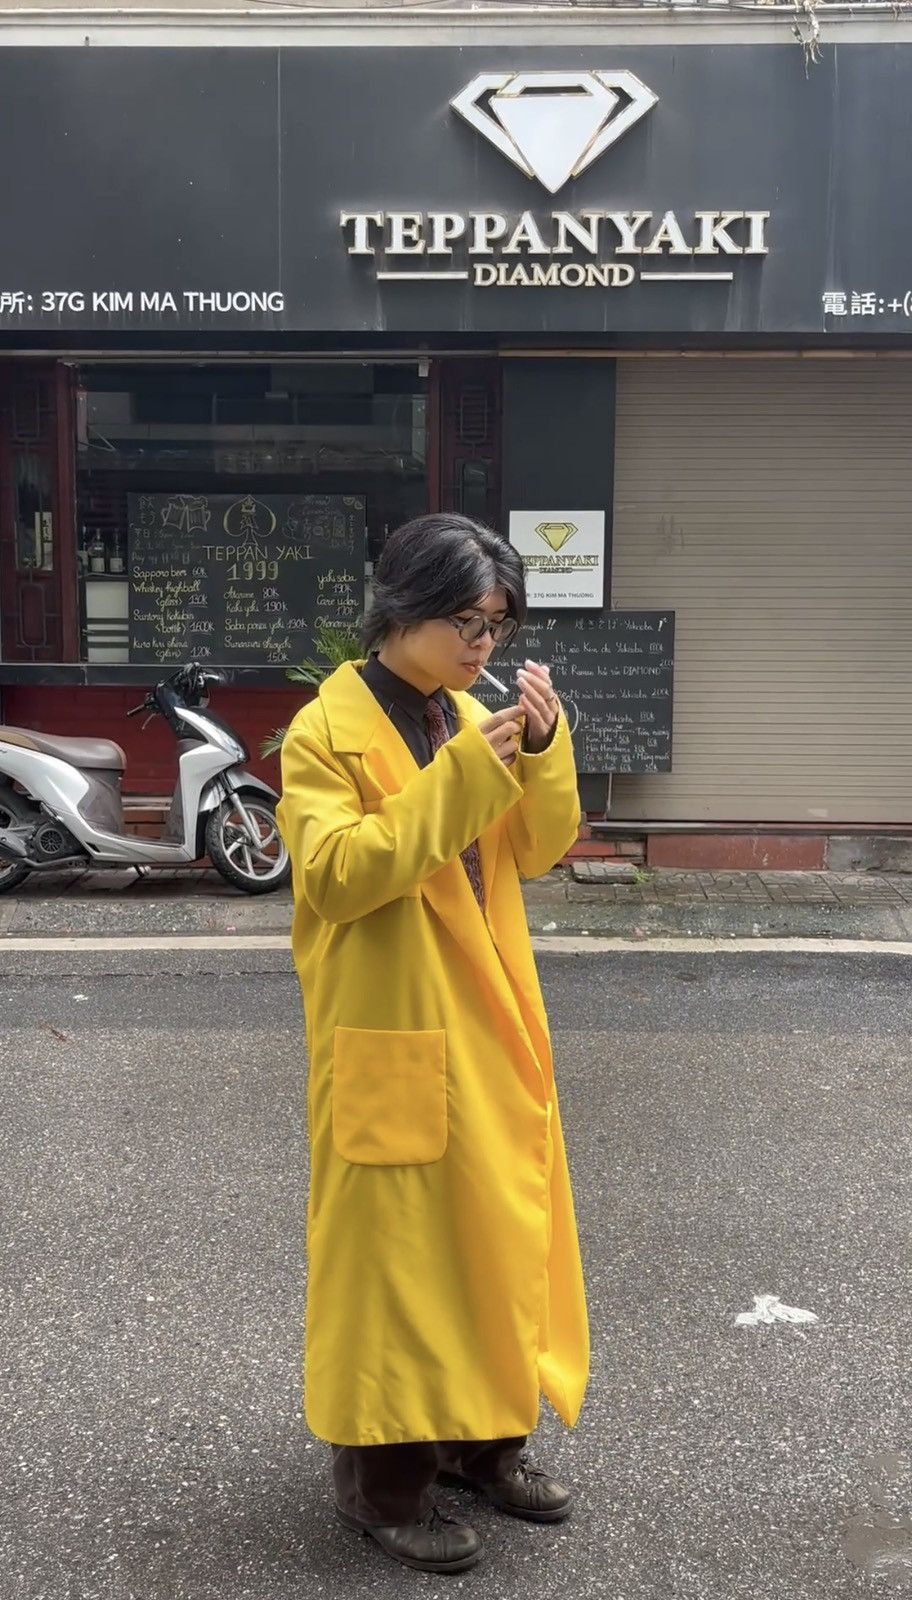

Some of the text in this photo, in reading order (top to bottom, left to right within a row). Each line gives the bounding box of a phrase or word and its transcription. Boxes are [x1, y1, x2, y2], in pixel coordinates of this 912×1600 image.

[340, 209, 770, 255] TEPPANYAKI
[473, 263, 635, 287] DIAMOND
[41, 291, 85, 312] 37G
[92, 291, 133, 312] KIM
[140, 291, 178, 312] MA
[183, 291, 284, 312] THUONG
[822, 291, 912, 317] 電話:+(
[202, 545, 268, 561] TEPPAN
[275, 545, 315, 561] YAKI
[226, 561, 279, 580] 1999
[623, 665, 661, 676] DIAMOND
